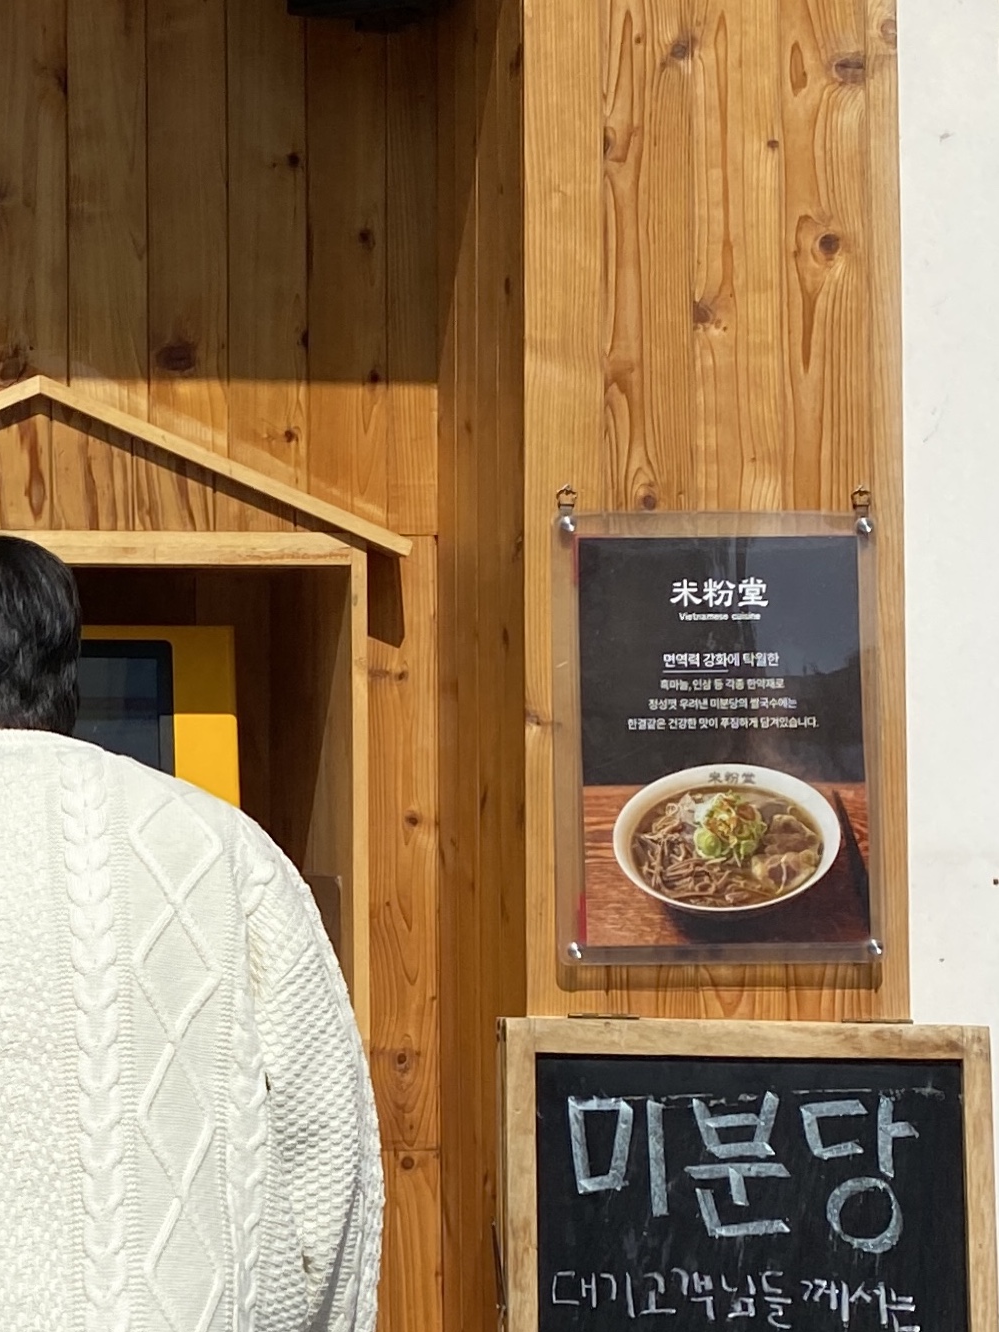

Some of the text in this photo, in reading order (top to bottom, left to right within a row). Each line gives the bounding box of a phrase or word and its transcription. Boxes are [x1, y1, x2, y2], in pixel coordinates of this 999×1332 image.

[669, 576, 769, 608] 米粉堂
[678, 612, 729, 621] Vietnamese
[663, 652, 780, 668] 면역력 강화에 탁월한
[714, 678, 724, 691] 등
[726, 678, 745, 691] 각종
[747, 678, 785, 690] 한약재로
[680, 698, 709, 710] 우려낸
[710, 698, 748, 710] 미분당의
[750, 697, 798, 710] 쌀국수에는
[627, 718, 667, 731] 한결같은
[668, 718, 697, 730] 건강한
[698, 718, 719, 730] 맛이
[720, 717, 759, 730] 푸짐하게
[568, 1091, 920, 1255] 미분당
